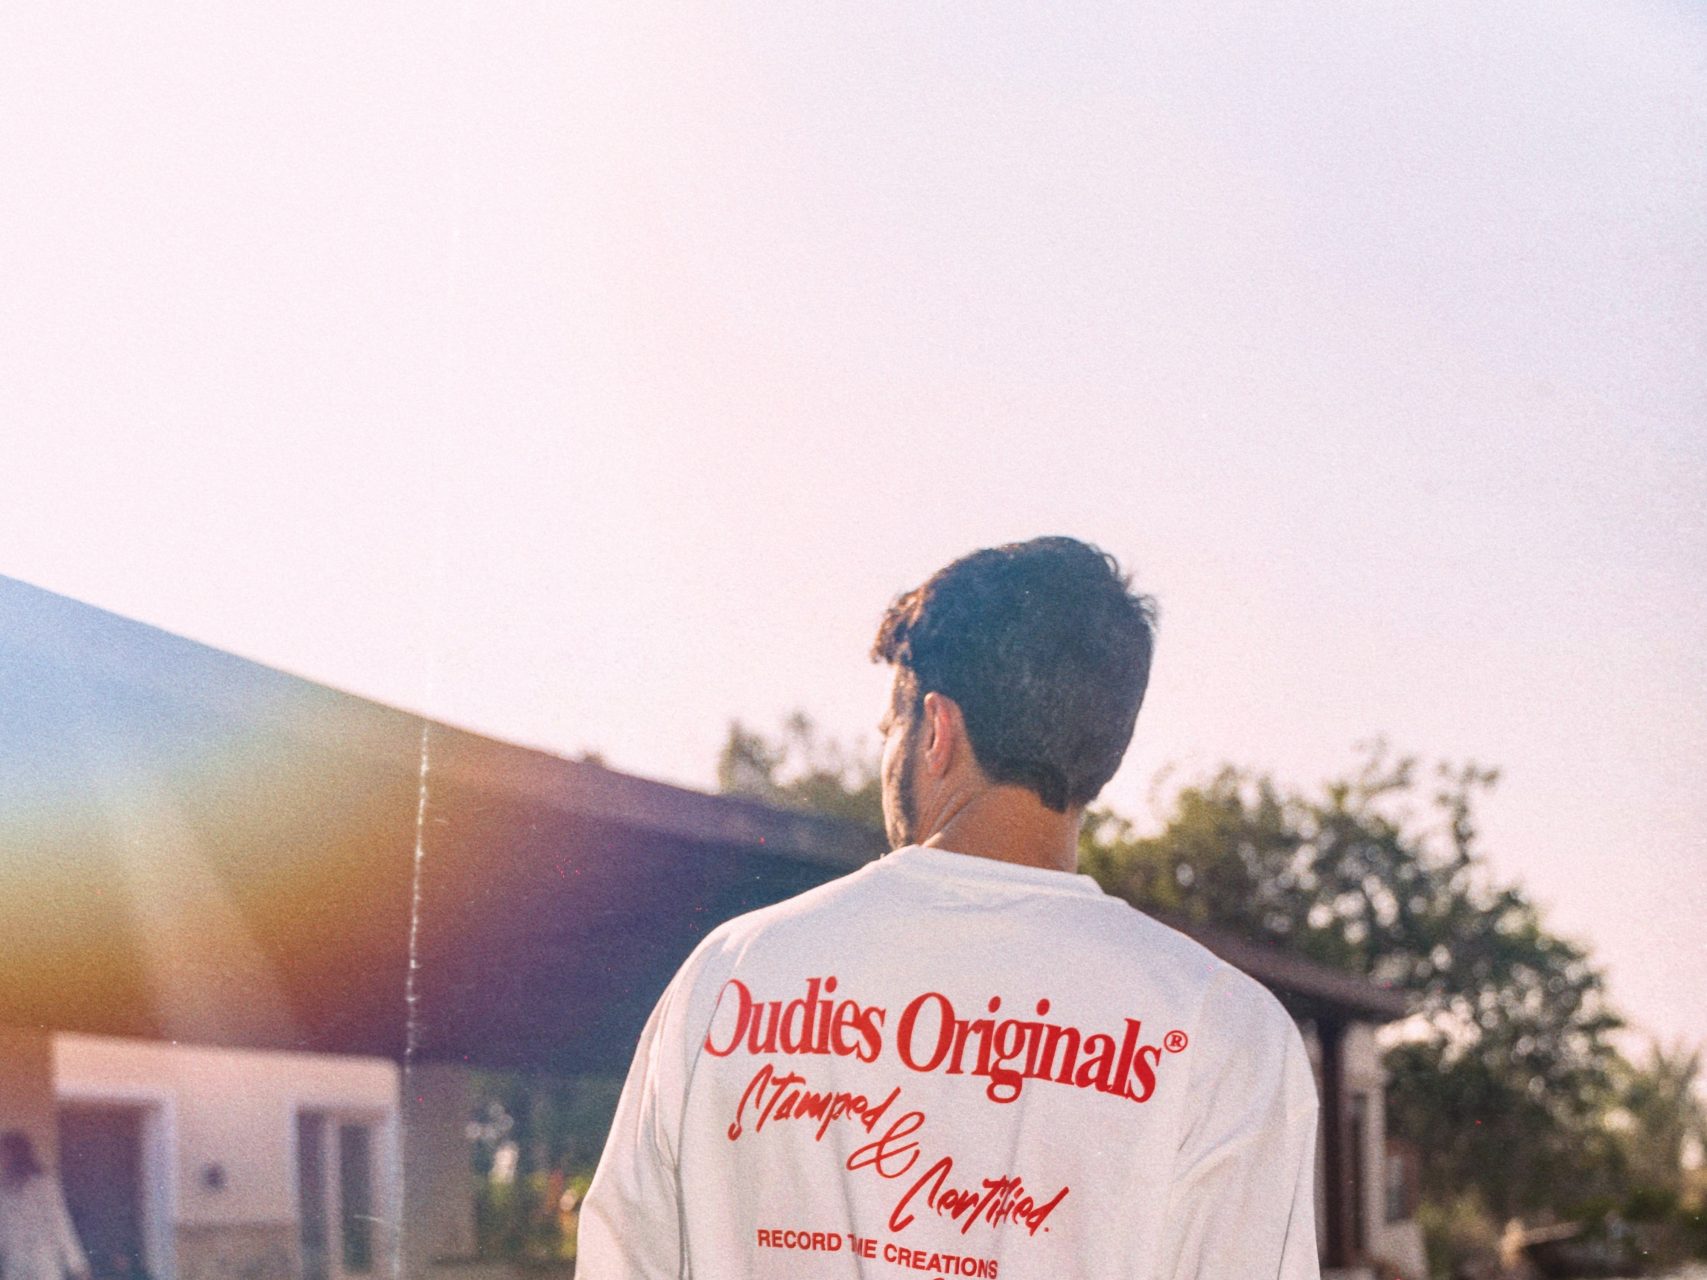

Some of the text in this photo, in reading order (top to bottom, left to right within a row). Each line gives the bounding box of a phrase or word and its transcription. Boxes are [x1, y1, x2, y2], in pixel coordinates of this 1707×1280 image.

[703, 975, 886, 1063] Oudies
[846, 1111, 926, 1180] &
[757, 1228, 843, 1252] RECORD
[883, 1242, 998, 1280] CREATIONS
